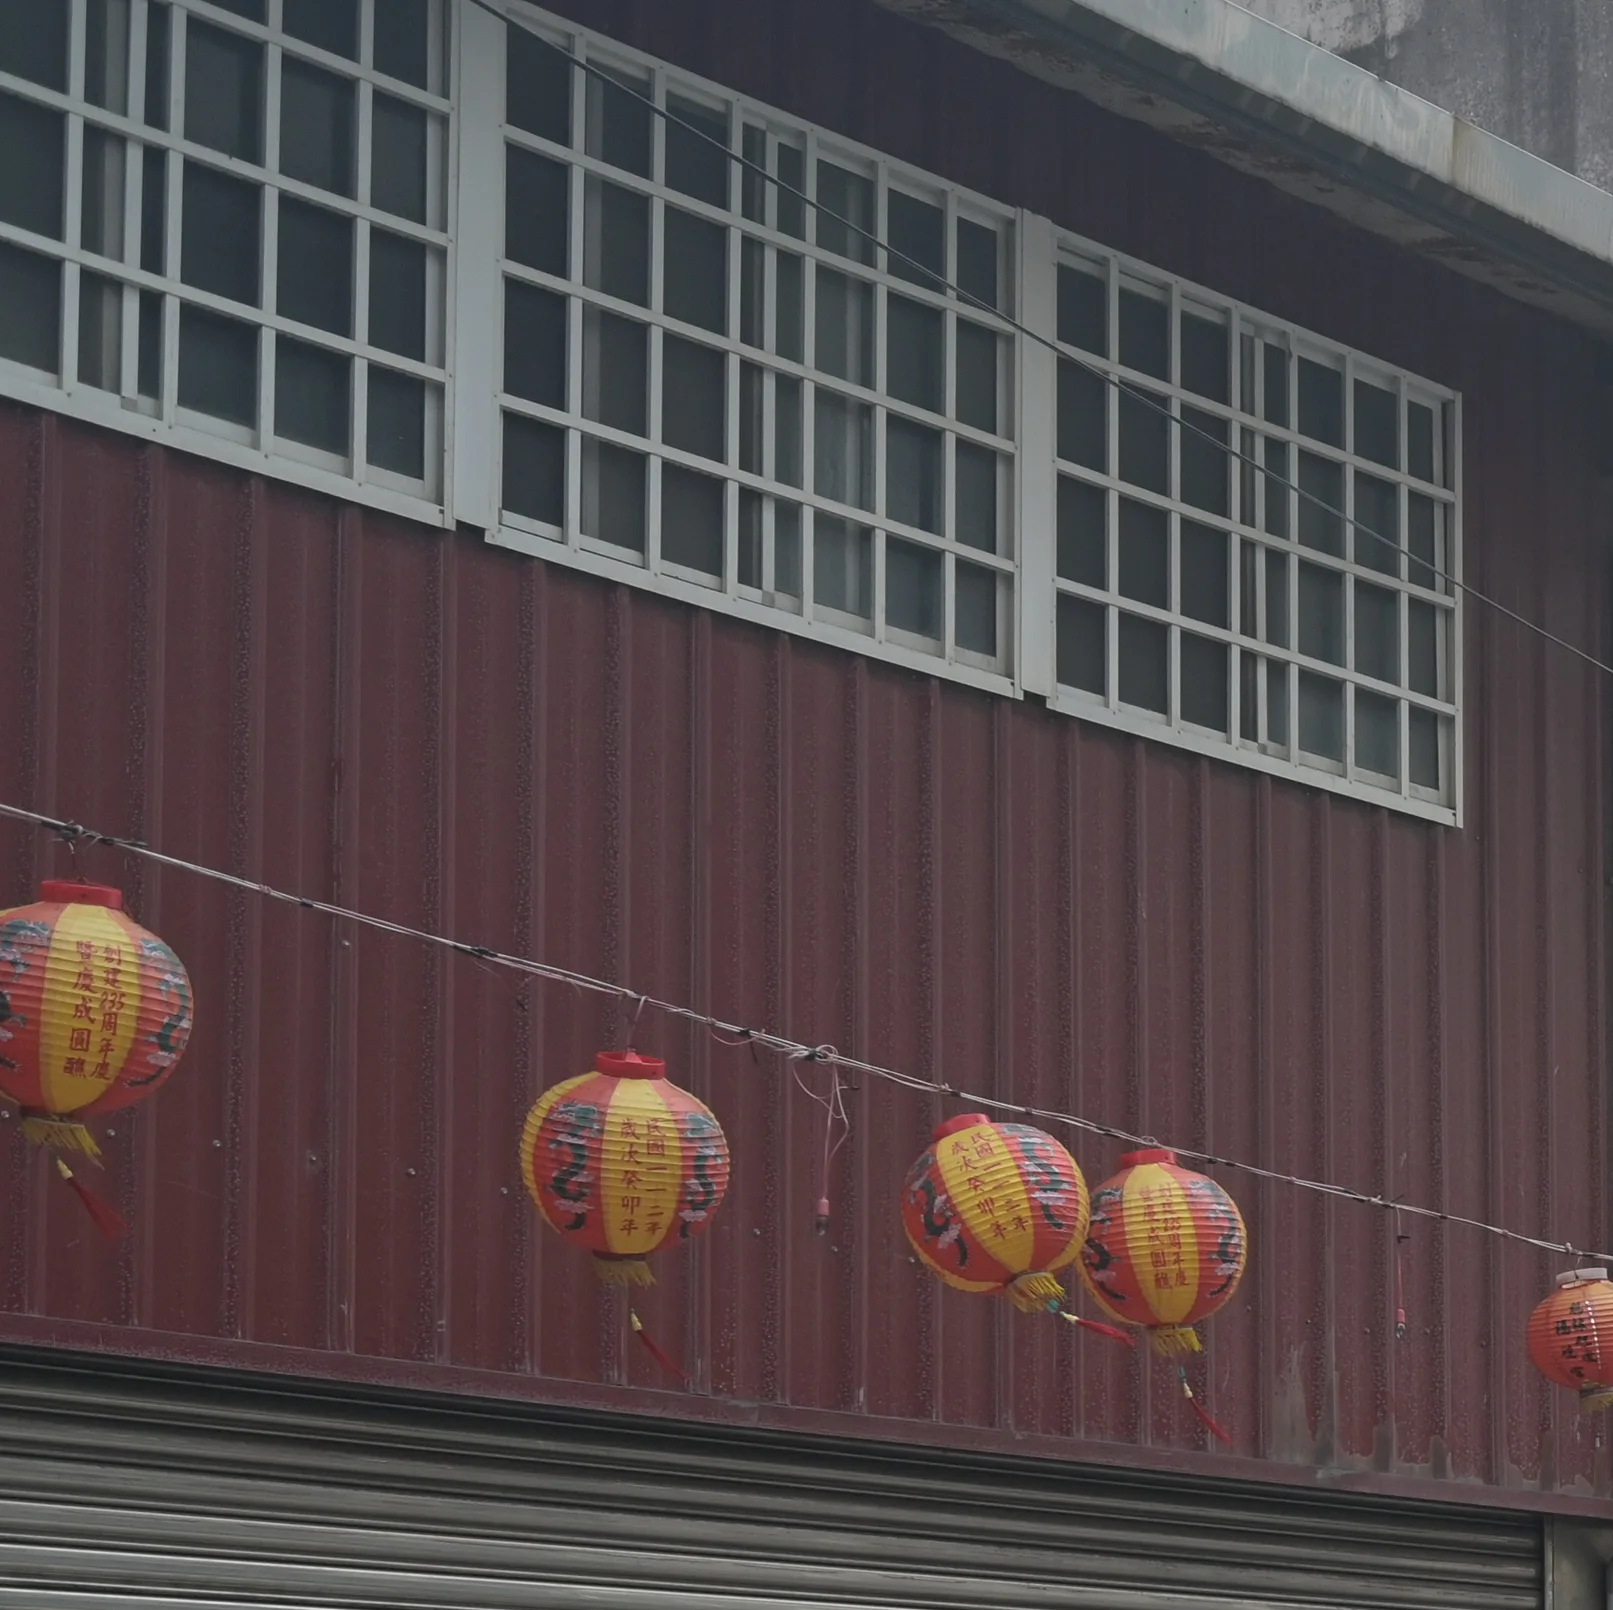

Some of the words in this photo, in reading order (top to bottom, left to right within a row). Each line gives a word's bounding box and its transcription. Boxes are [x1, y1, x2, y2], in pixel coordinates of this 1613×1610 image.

[619, 1118, 643, 1236] 歲次癸卯年
[645, 1117, 668, 1235] 民國一一二年
[951, 1141, 1008, 1239] 歲次癸卯年
[970, 1132, 1029, 1231] 民國一一二年
